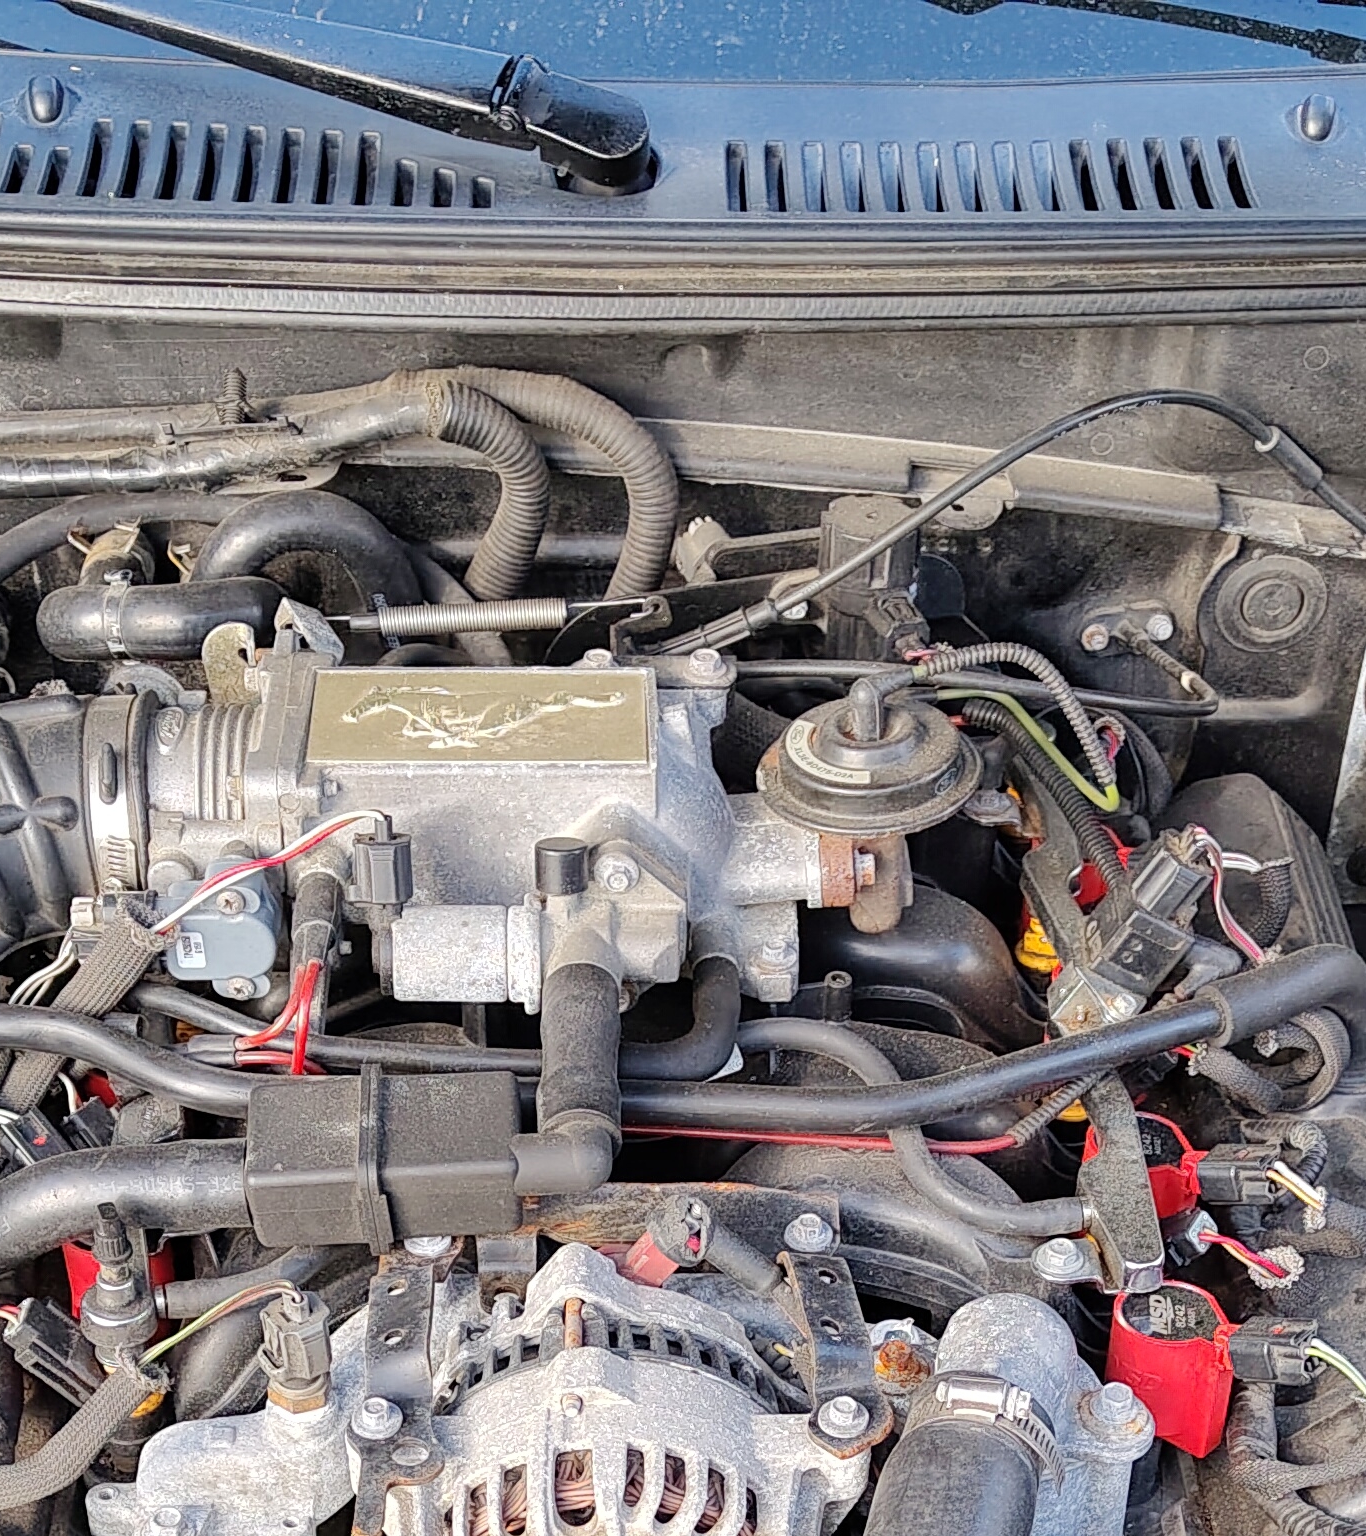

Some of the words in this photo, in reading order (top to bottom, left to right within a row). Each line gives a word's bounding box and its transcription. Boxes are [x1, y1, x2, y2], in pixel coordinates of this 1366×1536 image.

[1142, 1133, 1152, 1155] 8242
[1148, 1294, 1169, 1335] MSD
[1176, 1303, 1187, 1328] 8242
